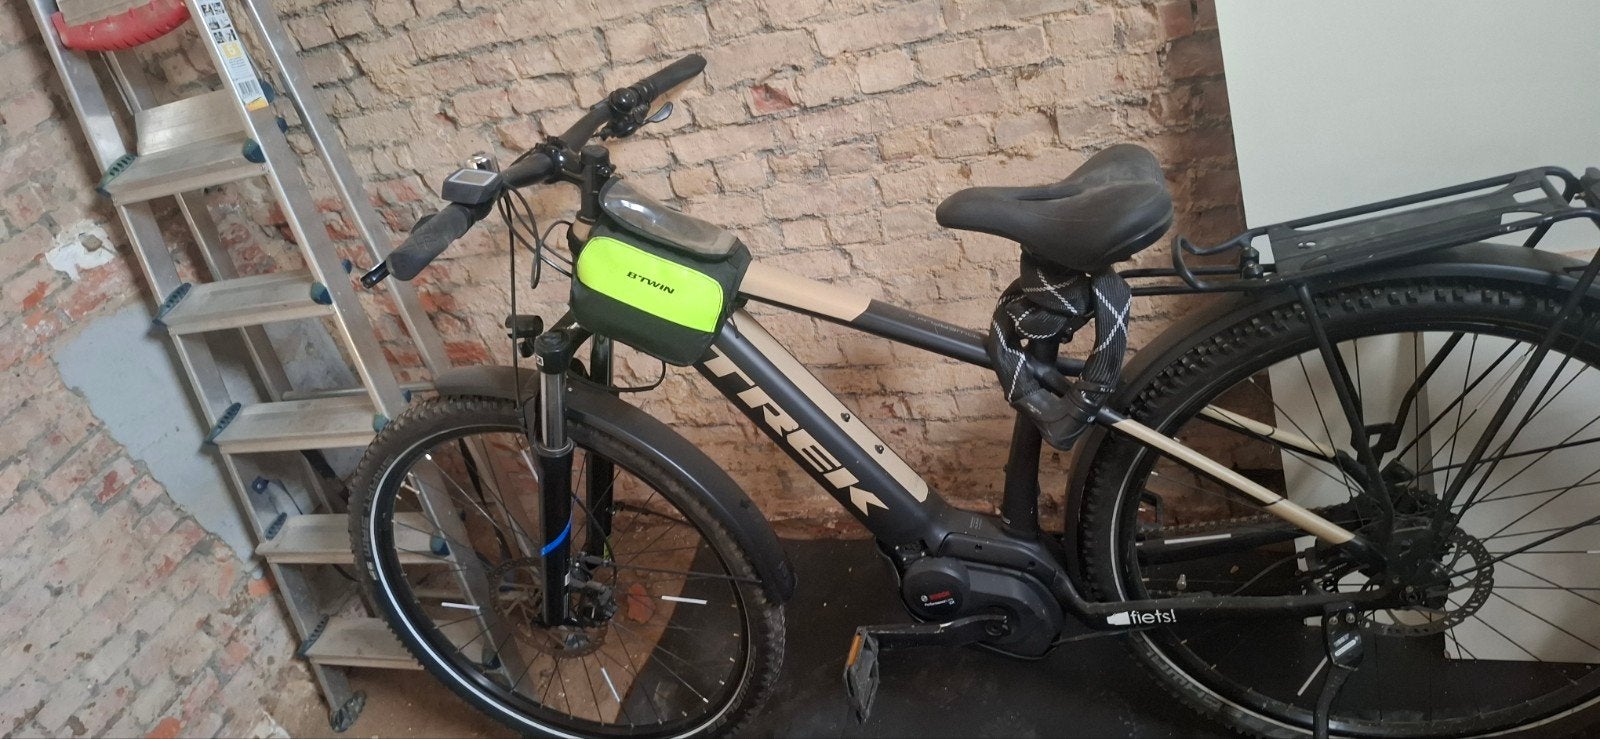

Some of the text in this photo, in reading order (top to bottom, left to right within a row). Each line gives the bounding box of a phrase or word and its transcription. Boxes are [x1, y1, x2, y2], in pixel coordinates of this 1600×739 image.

[626, 271, 675, 294] B'TWIN
[703, 344, 889, 517] TREK
[1130, 608, 1177, 625] fiets!
